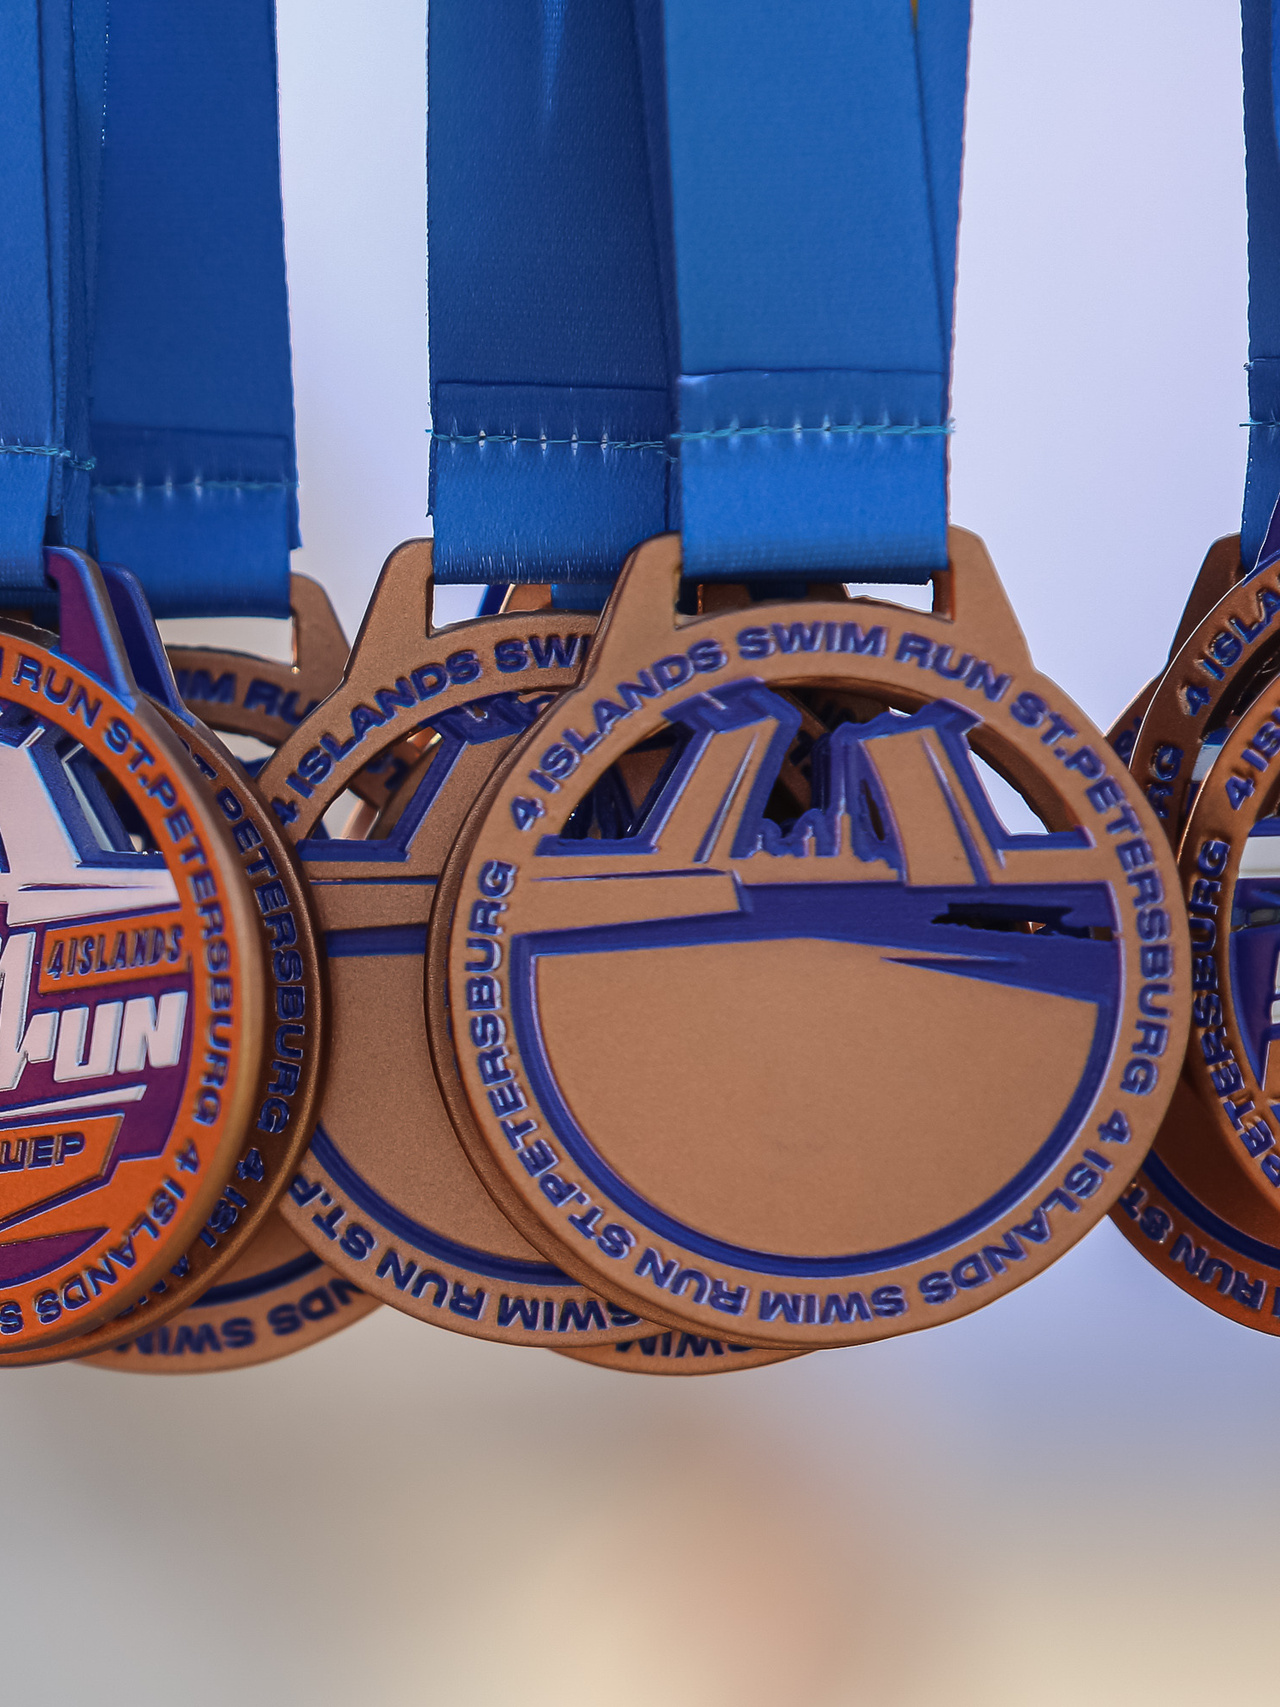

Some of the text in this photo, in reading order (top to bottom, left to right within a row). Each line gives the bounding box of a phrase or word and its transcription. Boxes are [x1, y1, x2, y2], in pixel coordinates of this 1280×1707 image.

[737, 622, 889, 662] SWIM
[892, 632, 1011, 703] RUN
[11, 656, 104, 729] RUN
[285, 650, 483, 798] ISLANDS
[529, 637, 729, 793] ISLANDS
[510, 796, 545, 831] 4
[1225, 775, 1255, 811] 4
[105, 726, 234, 1120] ST.PETERSBURG
[1009, 690, 1172, 1095] ST.PETERSBURG
[465, 859, 636, 1260] ST.PETERSBURG
[174, 1138, 200, 1175] 4
[1097, 1109, 1131, 1145] 4
[34, 1175, 186, 1327] ISLANDS
[918, 1149, 1114, 1303] ISLANDS
[375, 1248, 490, 1320] RUN
[634, 1248, 750, 1316] RUN
[758, 1285, 909, 1325] SWIM
[1170, 1233, 1267, 1310] RUN
